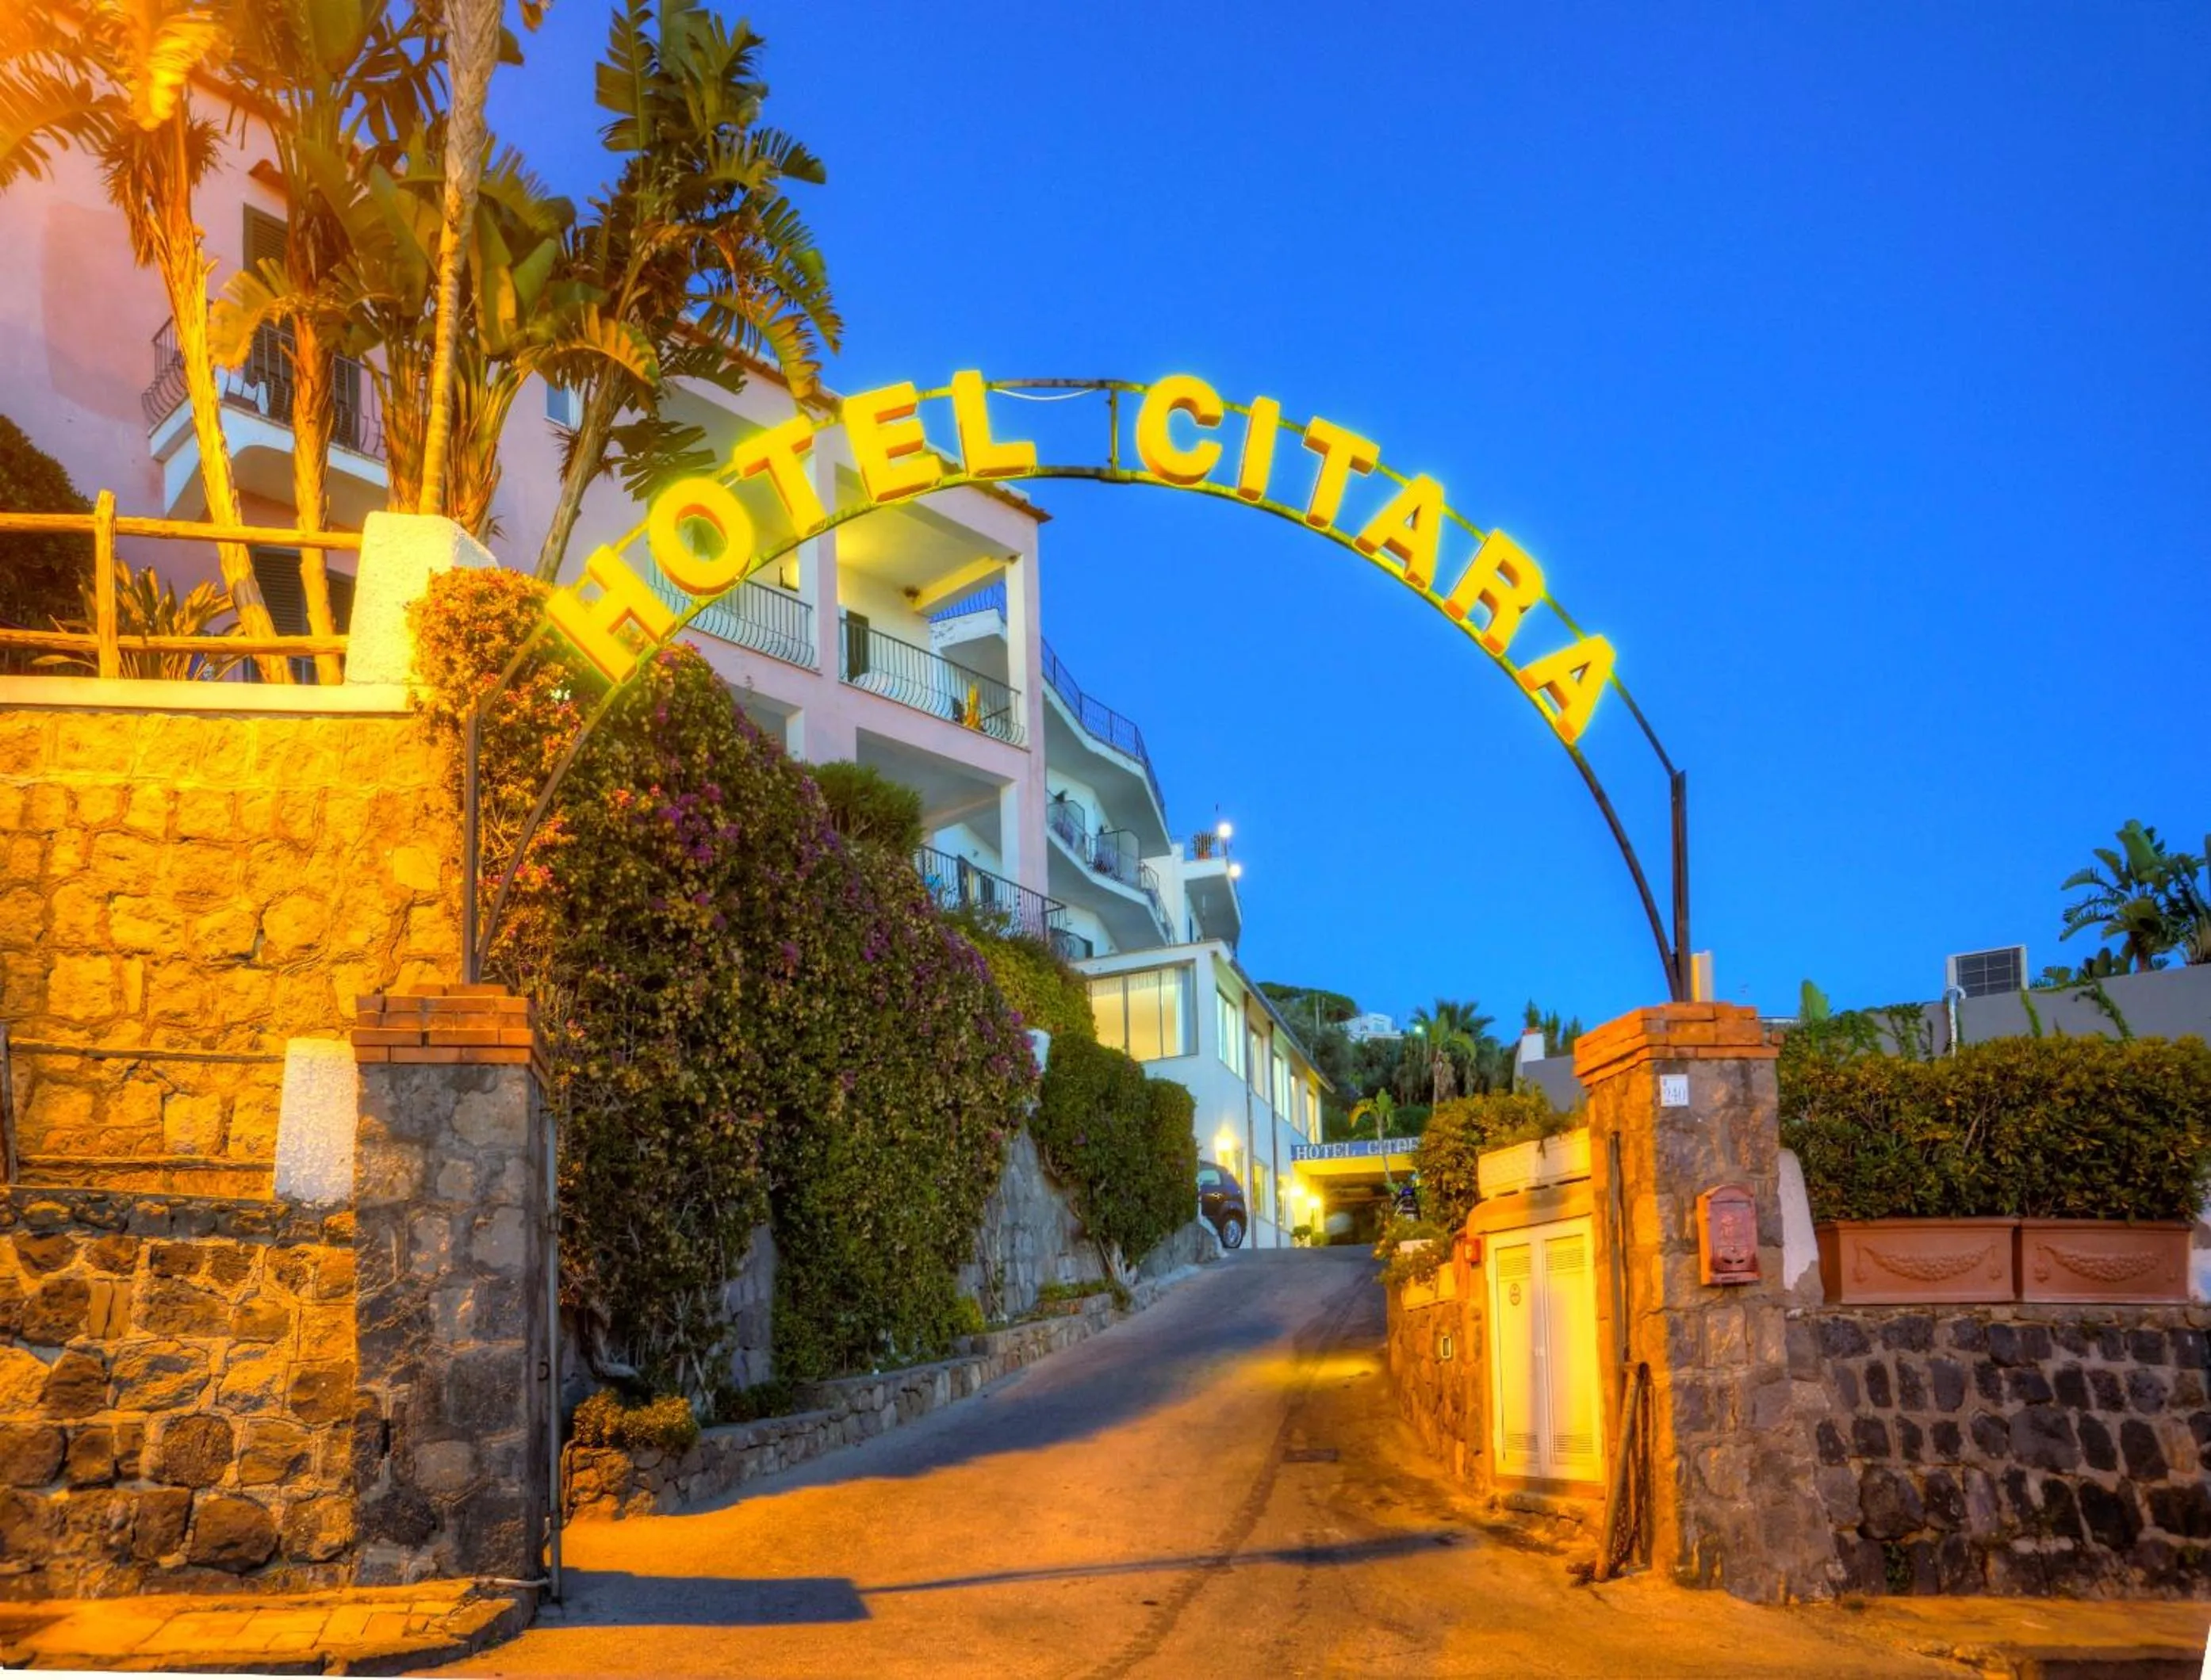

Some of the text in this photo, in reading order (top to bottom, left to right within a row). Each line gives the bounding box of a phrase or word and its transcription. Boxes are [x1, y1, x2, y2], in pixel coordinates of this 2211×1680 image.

[546, 369, 1616, 744] HOTEL CITARA
[1296, 1138, 1420, 1160] HOTEL CITAR
